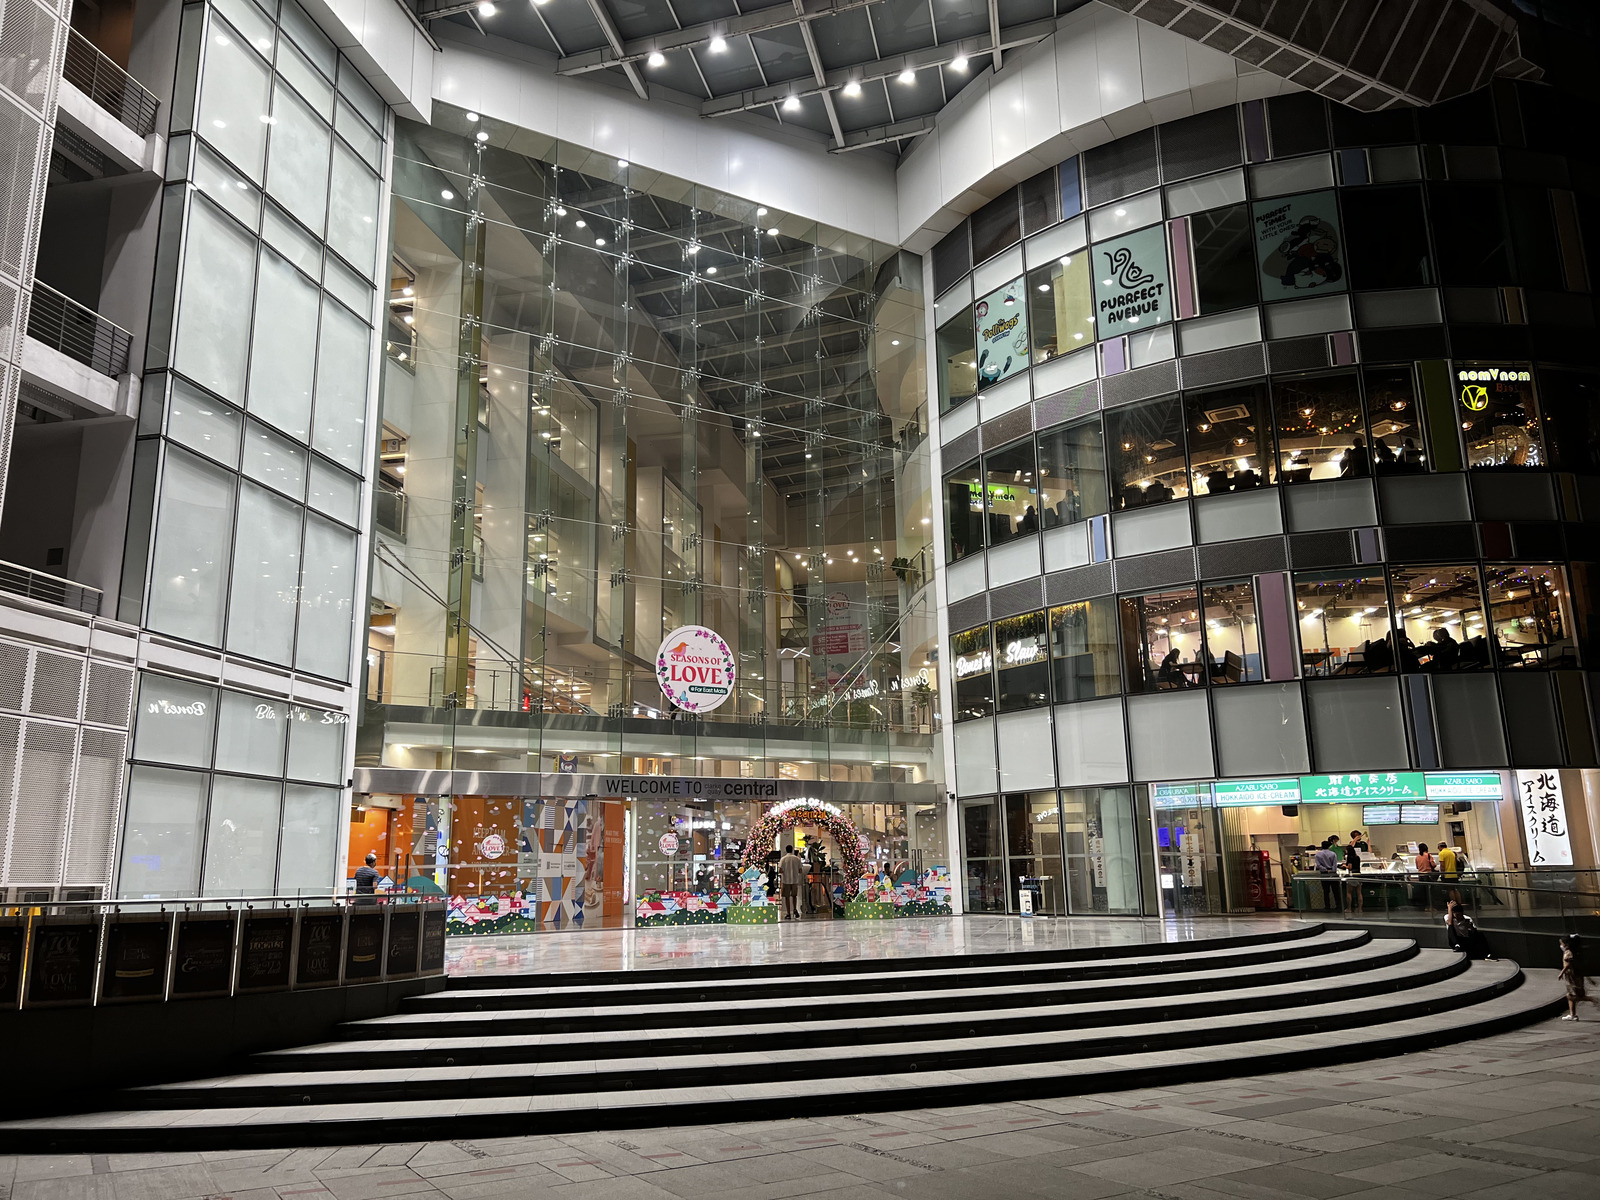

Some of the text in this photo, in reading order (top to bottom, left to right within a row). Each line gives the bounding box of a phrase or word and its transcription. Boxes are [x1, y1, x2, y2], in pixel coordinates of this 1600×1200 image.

[1256, 204, 1291, 223] PURRFECT
[1261, 219, 1292, 235] WITH YOUR
[1260, 231, 1278, 241] LITTLE
[1100, 283, 1164, 312] PURRFECT
[1108, 299, 1158, 324] AVENUE
[1459, 368, 1531, 381] nomVnom
[671, 654, 722, 665] SEASONS OF
[671, 664, 722, 684] LOVE
[606, 779, 702, 794] WELCOME TO
[724, 780, 778, 796] central
[1315, 785, 1412, 797] 北海道アイスクリーム
[1221, 792, 1295, 801] HOKKAIDO ICE-CREAM
[1537, 772, 1565, 837] 北海道
[770, 797, 807, 816] SEASONS
[807, 797, 820, 807] OF
[820, 800, 842, 817] LOVE
[1522, 780, 1545, 863] アイスクリーム
